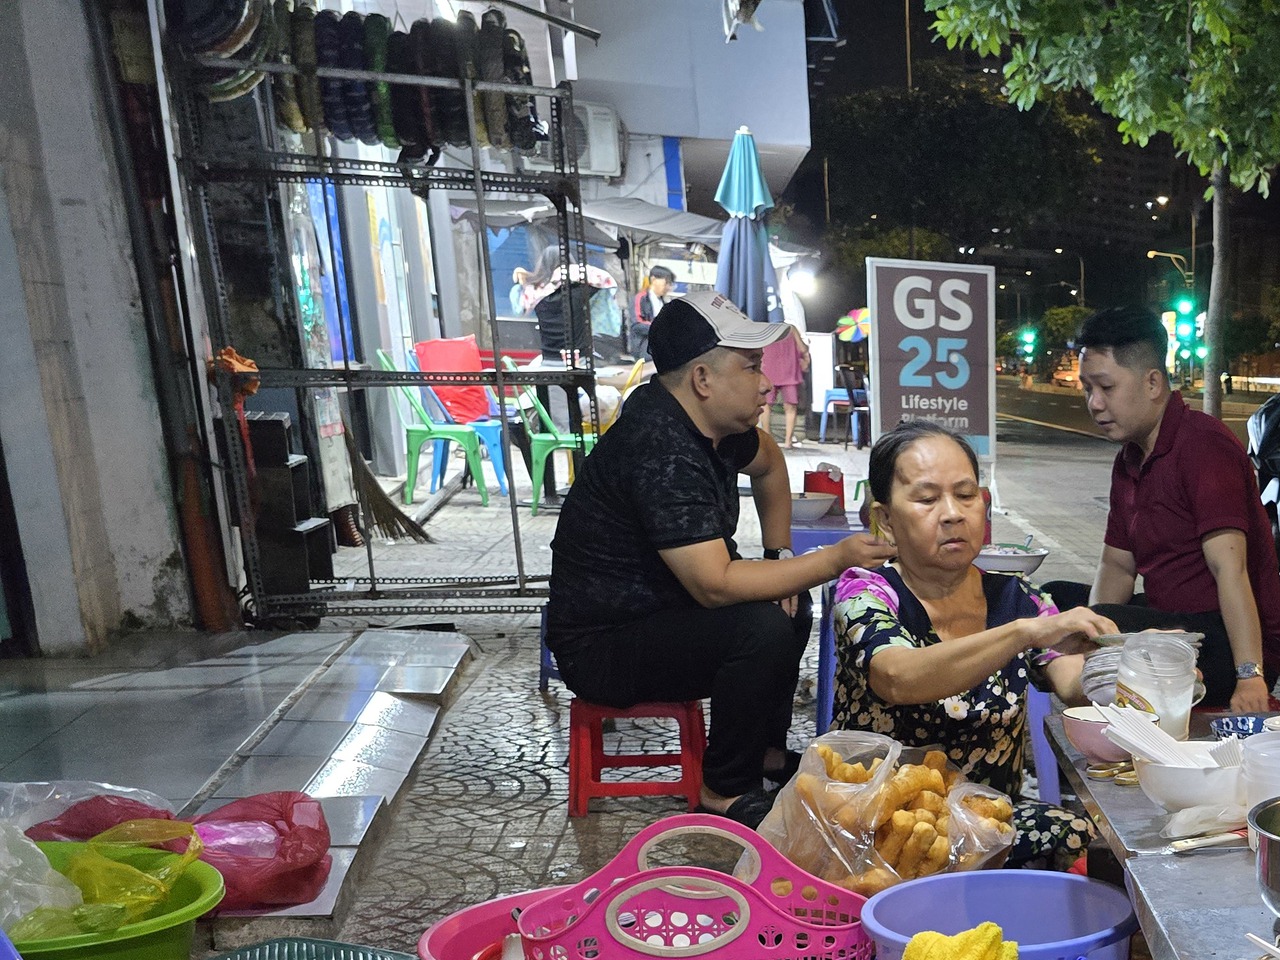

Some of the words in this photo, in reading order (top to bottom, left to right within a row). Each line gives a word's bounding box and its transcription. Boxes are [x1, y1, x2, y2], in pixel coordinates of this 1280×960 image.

[893, 275, 973, 331] GS
[898, 335, 971, 390] 25
[901, 394, 969, 413] Lifestyle
